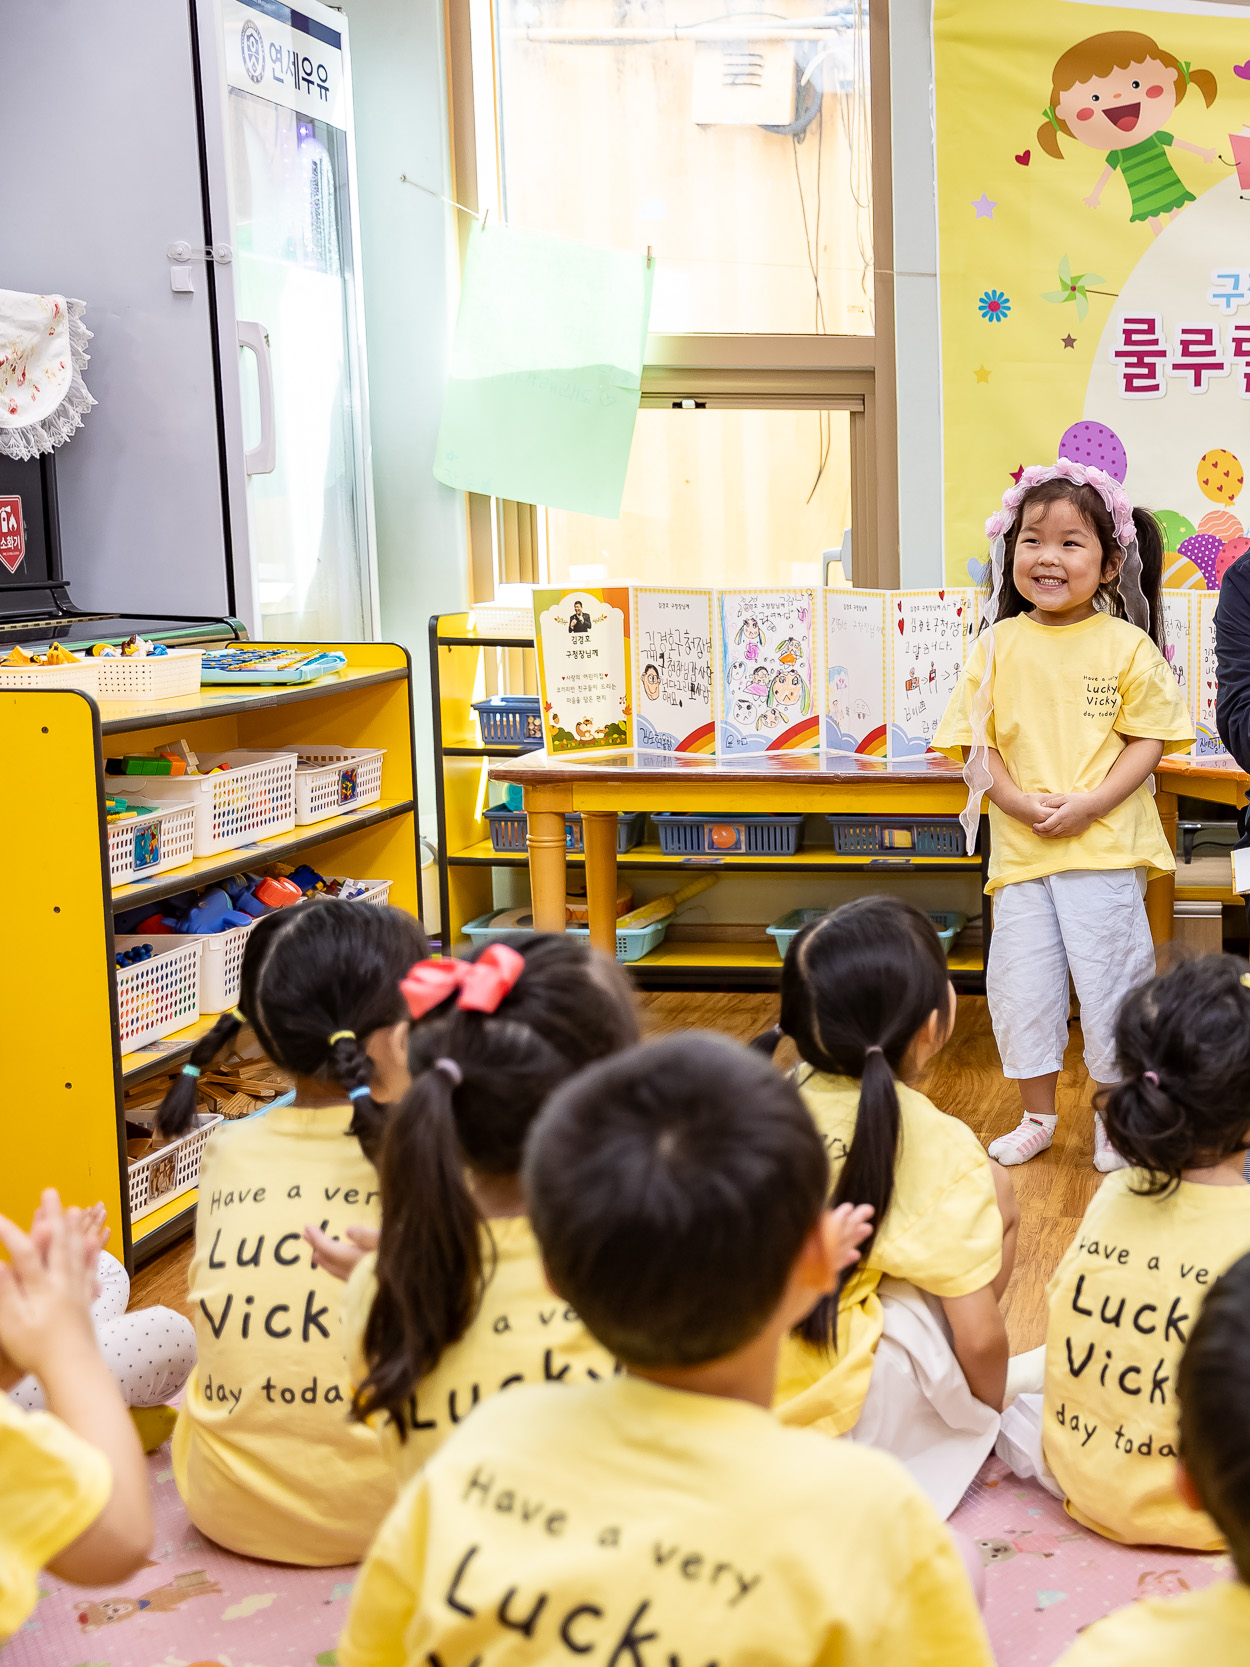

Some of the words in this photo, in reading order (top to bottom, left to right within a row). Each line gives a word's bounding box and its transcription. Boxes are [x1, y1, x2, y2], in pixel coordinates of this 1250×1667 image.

[268, 42, 330, 102] 연세우유
[0, 534, 21, 550] 소화기
[566, 649, 599, 659] 구청장님께
[1086, 683, 1118, 696] Lucky
[1086, 695, 1117, 709] Vicky
[1083, 710, 1095, 719] day
[209, 1186, 267, 1216] Have
[287, 1184, 302, 1200] a
[324, 1186, 380, 1206] ver
[208, 1218, 340, 1270] Luc
[1147, 1256, 1160, 1271] a
[1179, 1262, 1210, 1285] ve
[199, 1289, 331, 1343] Vick
[492, 1315, 512, 1335] a
[1072, 1274, 1189, 1345] Luck
[1065, 1336, 1170, 1405] Vick
[204, 1373, 242, 1415] day
[261, 1376, 344, 1405] toda
[1055, 1402, 1097, 1447] day
[1114, 1424, 1178, 1458] toda
[462, 1463, 568, 1537] Have
[597, 1525, 622, 1549] a
[652, 1541, 762, 1607] very
